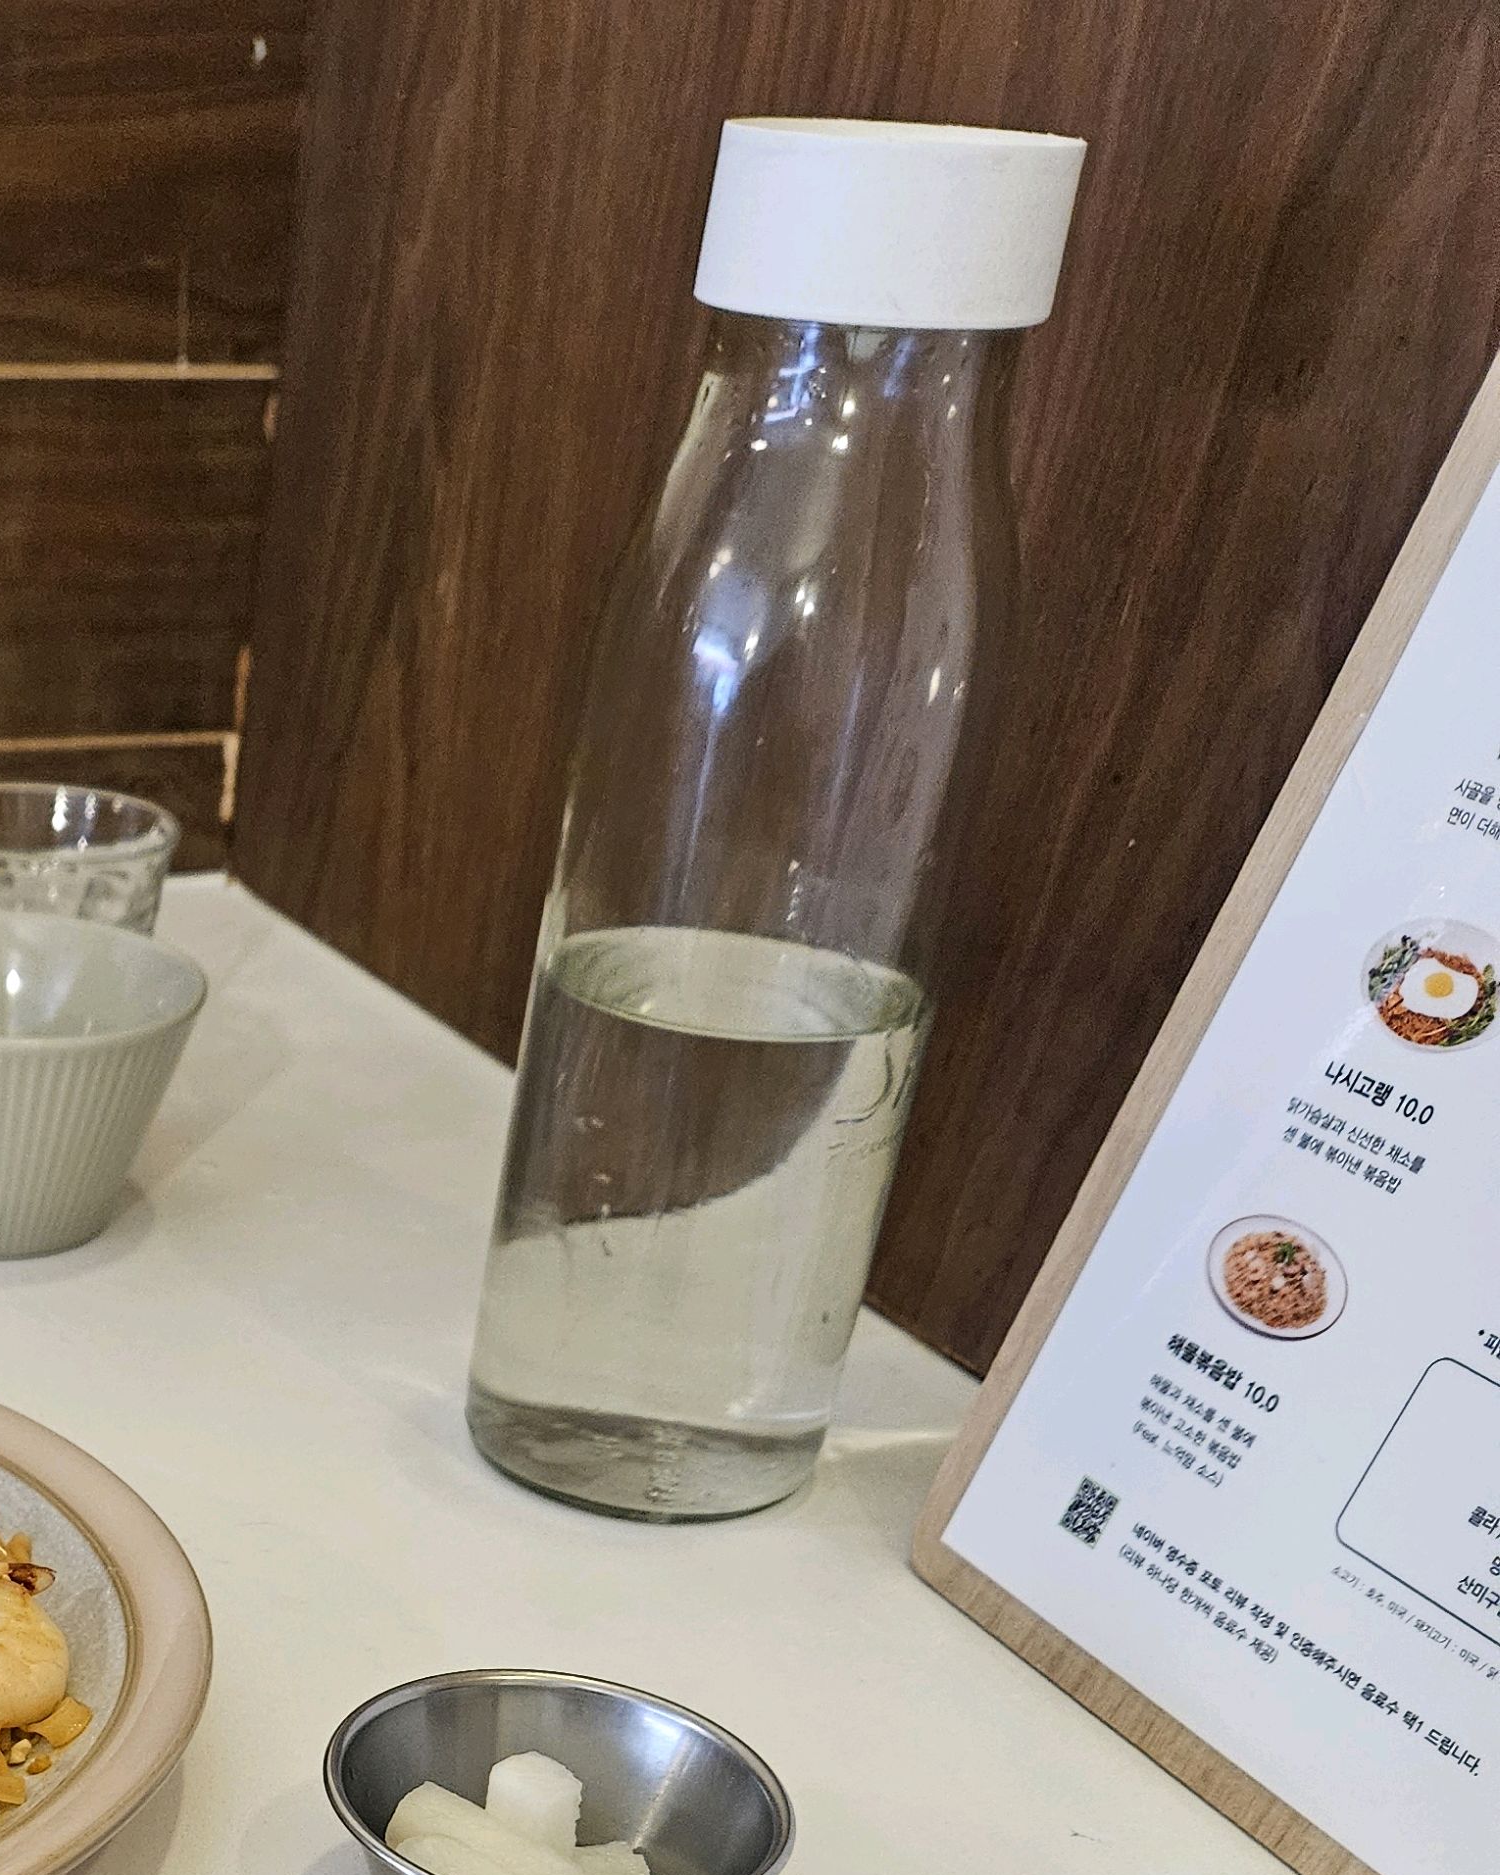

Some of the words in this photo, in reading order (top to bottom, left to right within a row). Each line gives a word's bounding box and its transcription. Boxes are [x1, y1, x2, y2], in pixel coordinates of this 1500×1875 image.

[1454, 779, 1495, 805] 사골을
[1447, 807, 1476, 830] 면이
[1325, 1061, 1394, 1107] 나시고랭
[1395, 1094, 1435, 1125] 10.0
[1286, 1097, 1347, 1136] 닭가슴살과
[1347, 1126, 1386, 1155] 신선한
[1385, 1144, 1426, 1174] 채소를
[1325, 1145, 1364, 1175] 볶아낸
[1363, 1164, 1403, 1195] 볶음밥
[1167, 1333, 1244, 1391] 해물볶음밥
[1207, 1438, 1243, 1470] 볶음밥
[1457, 1575, 1500, 1618] 산미구
[1213, 1611, 1248, 1641] 음료수
[1132, 1522, 1166, 1553] 네이버
[1165, 1545, 1200, 1576] 영수증
[1198, 1570, 1224, 1593] 포토
[1224, 1586, 1249, 1610] 리뷰
[1250, 1603, 1275, 1629] 작성
[1360, 1683, 1400, 1716] 음료수
[1402, 1710, 1425, 1733] 택1
[1424, 1728, 1481, 1777] 드립니다.
